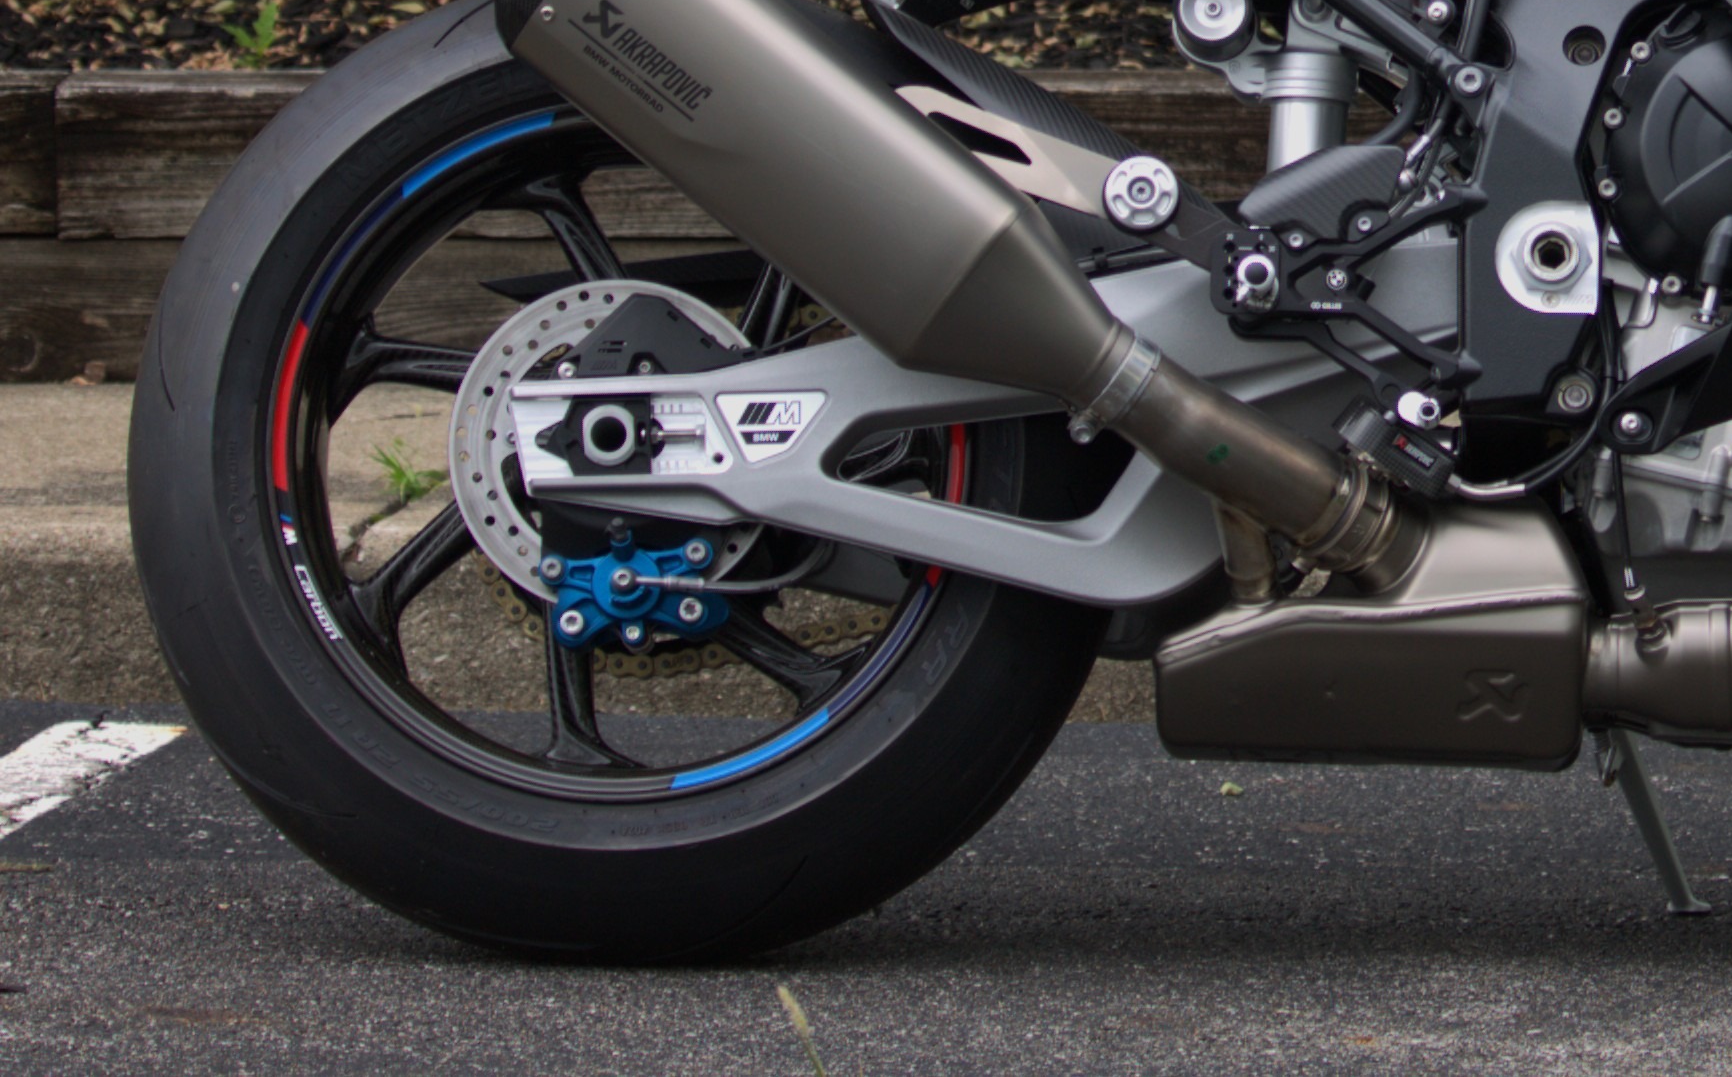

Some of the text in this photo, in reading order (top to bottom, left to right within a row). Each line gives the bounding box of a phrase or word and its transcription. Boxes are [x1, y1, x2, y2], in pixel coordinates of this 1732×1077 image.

[583, 44, 664, 113] BMW MOTORRAD
[612, 27, 713, 111] AKRAPOVIČ
[752, 432, 779, 443] BMW
[294, 565, 343, 640] Carbon
